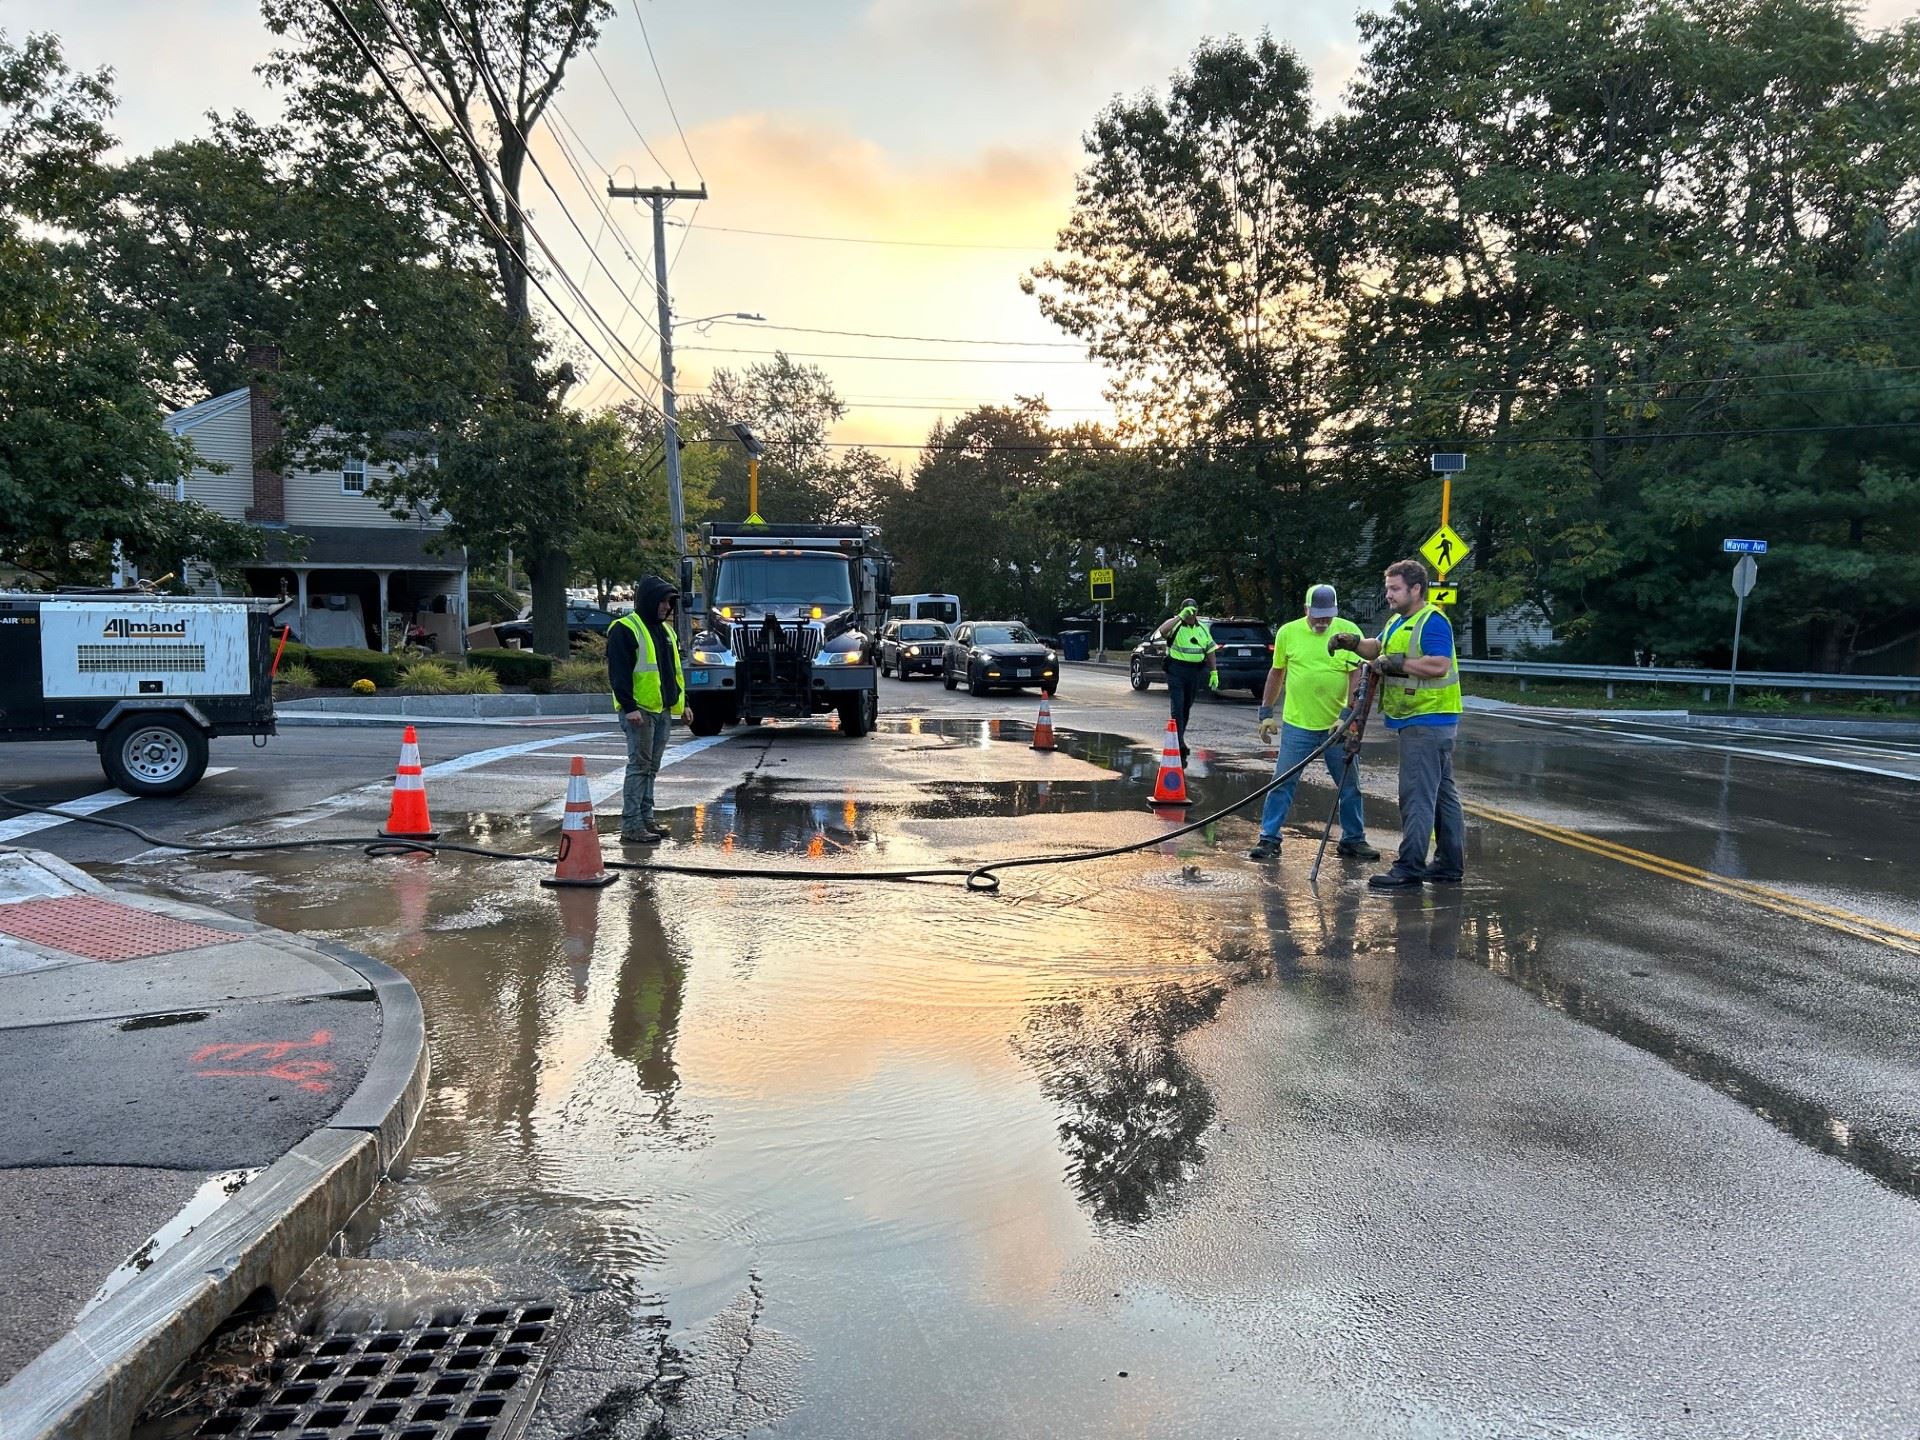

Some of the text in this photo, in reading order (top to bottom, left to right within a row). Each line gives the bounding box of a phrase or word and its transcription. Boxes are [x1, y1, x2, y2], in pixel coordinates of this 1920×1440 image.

[1727, 541, 1765, 551] Wayne Ave
[103, 618, 185, 637] Allmand
